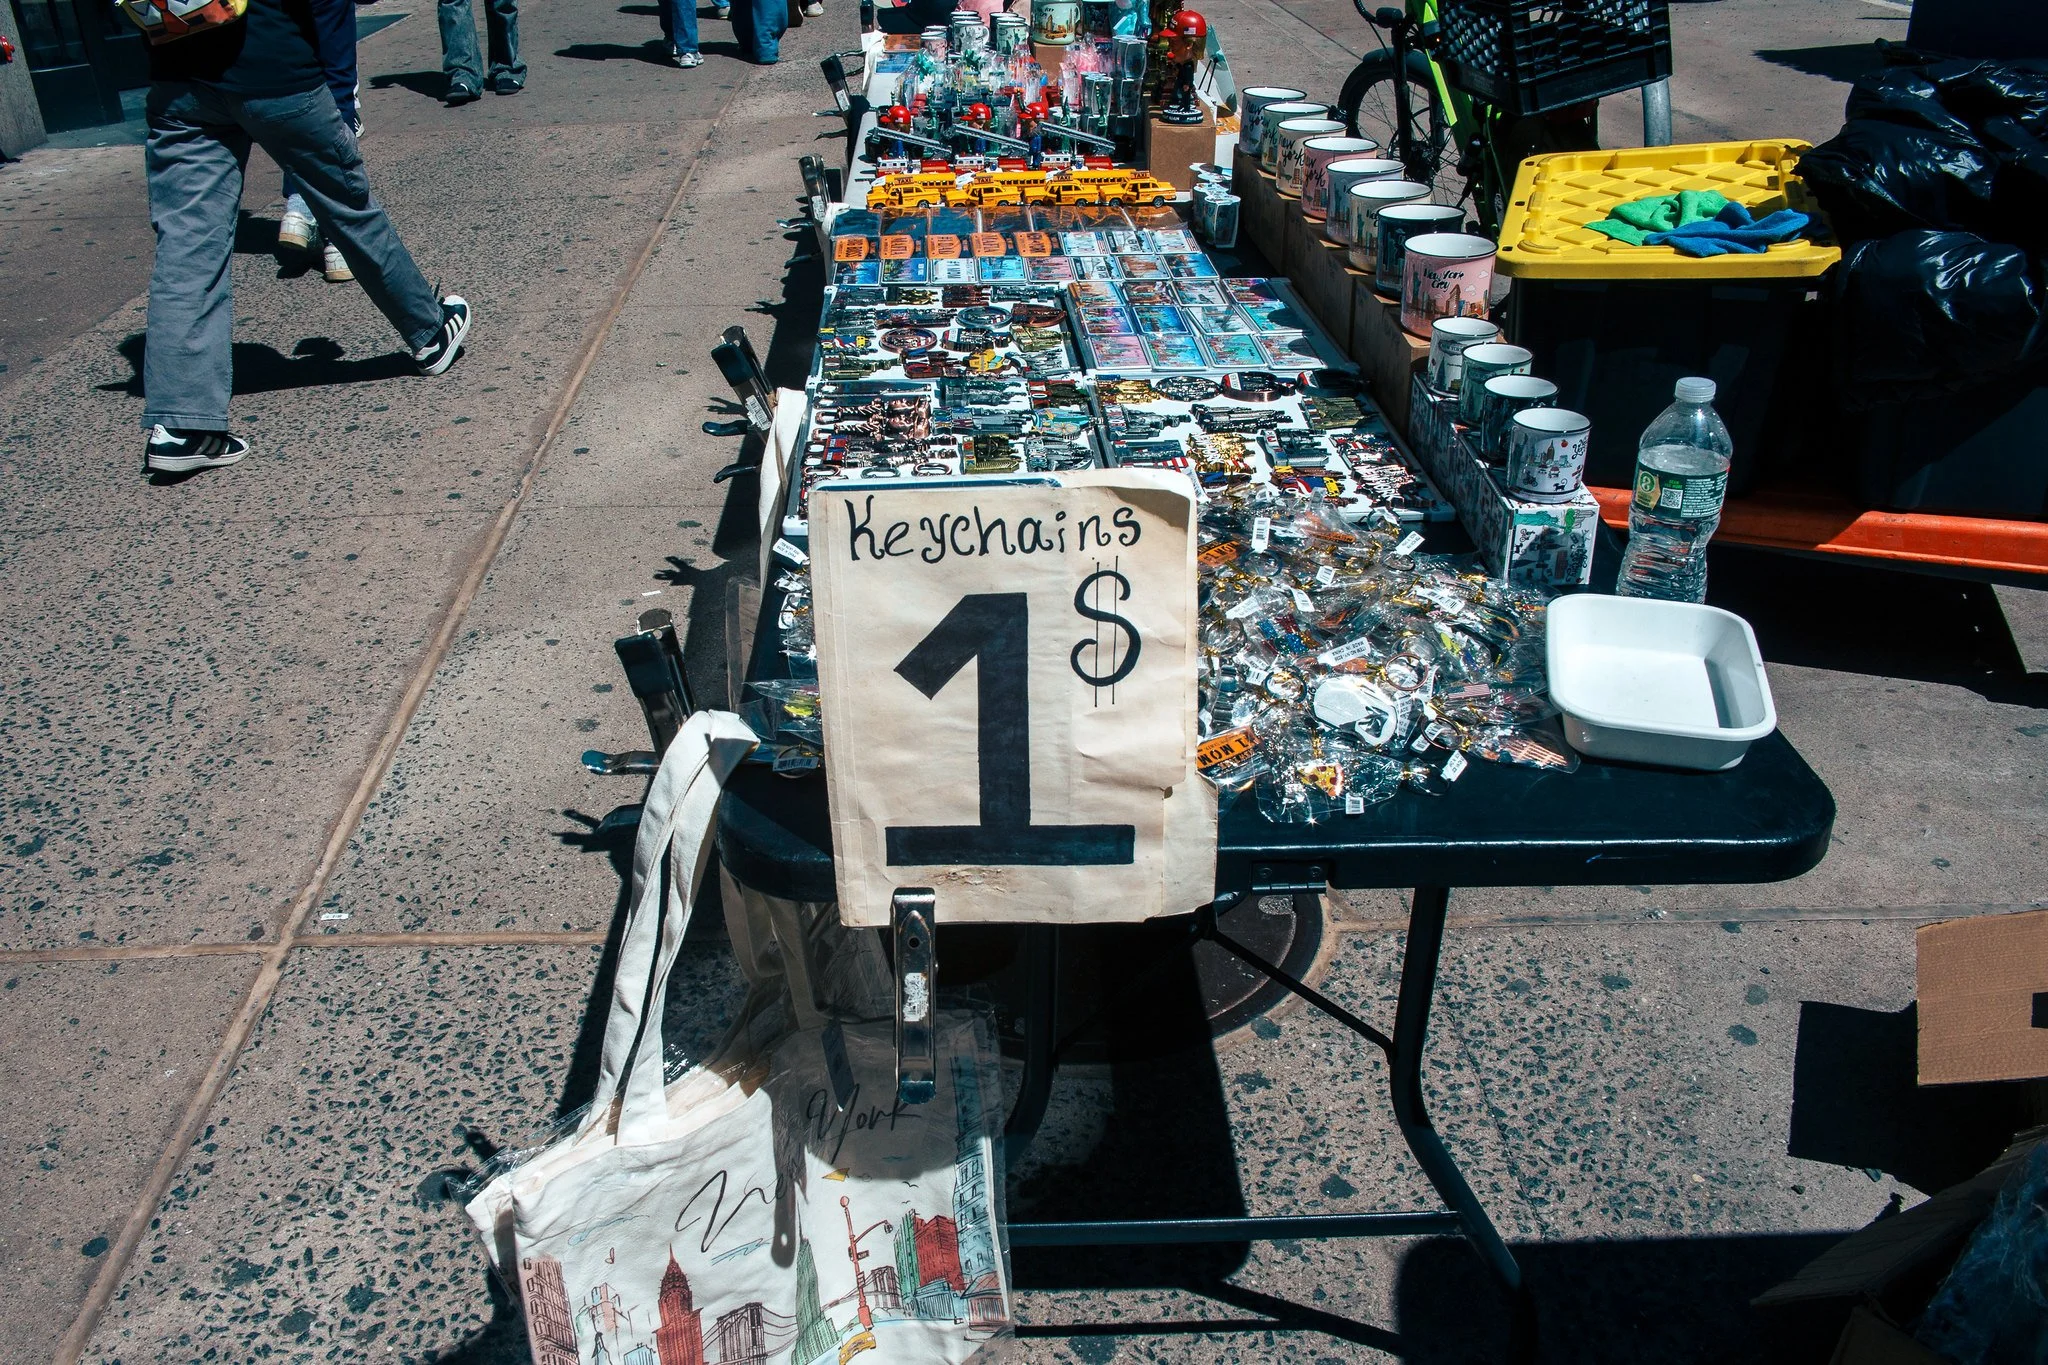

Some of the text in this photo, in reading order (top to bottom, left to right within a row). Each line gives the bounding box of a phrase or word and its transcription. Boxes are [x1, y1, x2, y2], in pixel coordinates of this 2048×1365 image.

[845, 495, 1142, 564] Keychains
[886, 592, 1135, 866] 1
[1197, 743, 1235, 766] MOM
